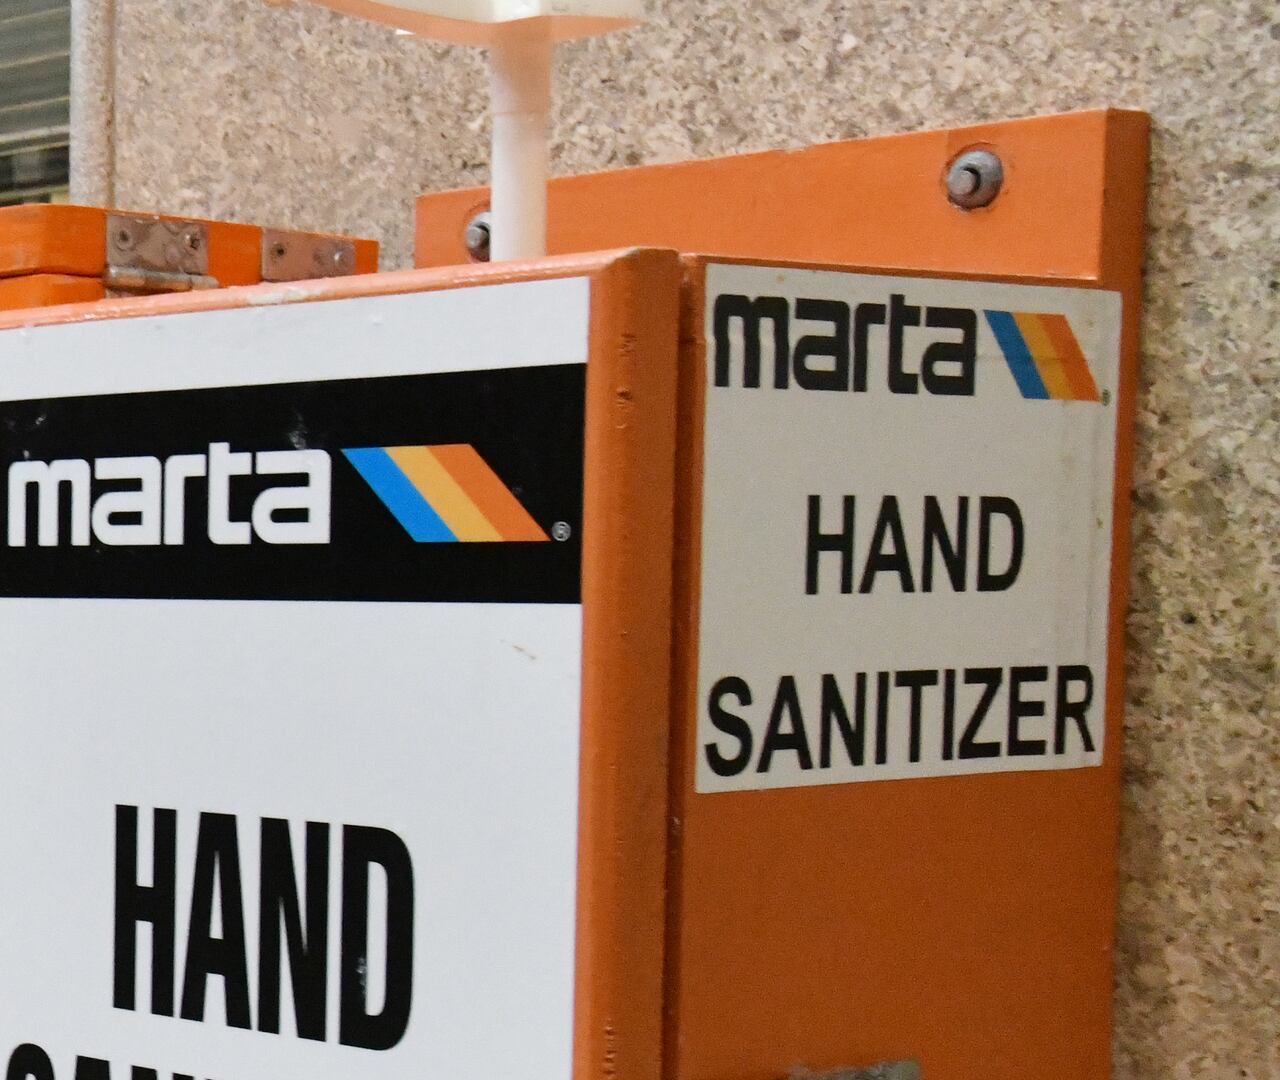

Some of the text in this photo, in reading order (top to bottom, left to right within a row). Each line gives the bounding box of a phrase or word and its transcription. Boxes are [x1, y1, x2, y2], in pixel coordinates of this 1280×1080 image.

[713, 293, 978, 396] marta
[7, 441, 332, 547] marta
[804, 494, 1025, 596] HAND
[704, 664, 1096, 778] SANITIZER
[112, 803, 416, 1052] HAND
